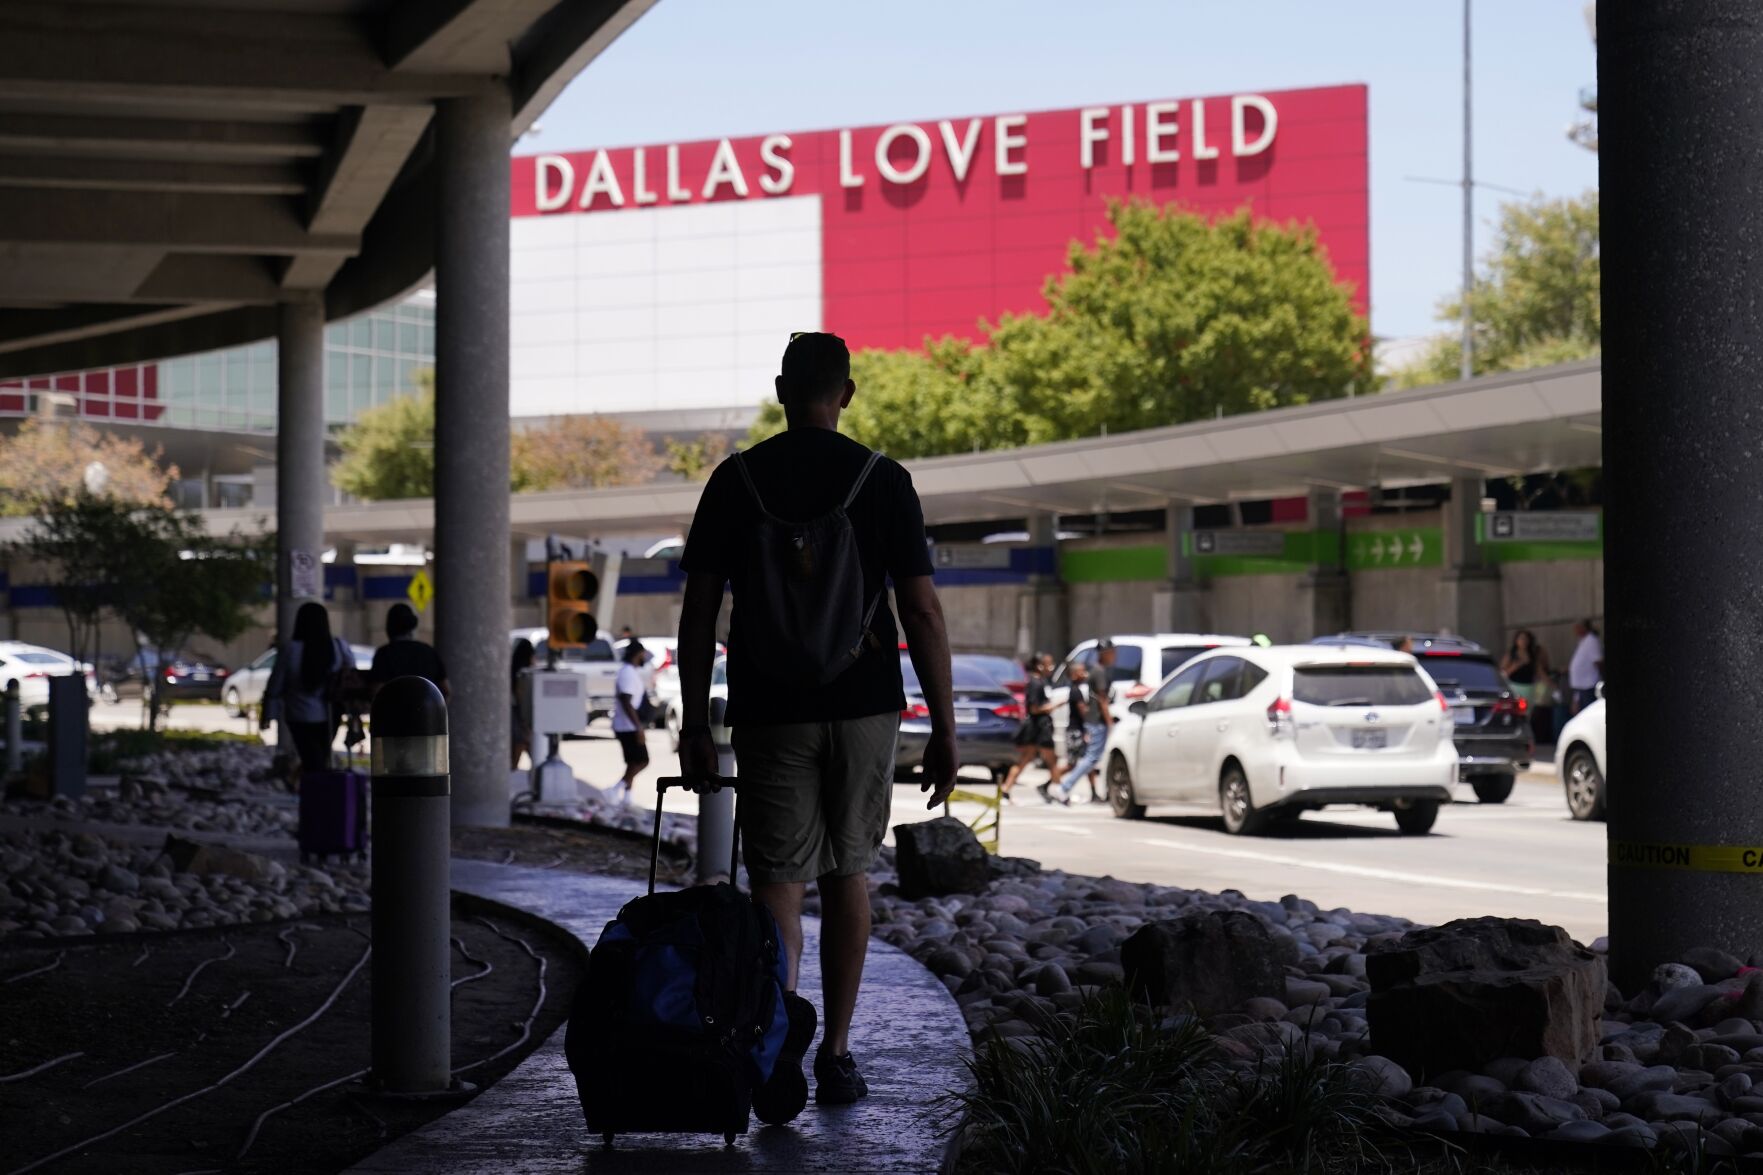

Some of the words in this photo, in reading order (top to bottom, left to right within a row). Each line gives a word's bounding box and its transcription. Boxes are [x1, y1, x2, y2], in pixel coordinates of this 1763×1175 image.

[535, 134, 795, 211] DALLAS
[839, 114, 1028, 188] LOVE
[1080, 94, 1278, 168] FIELD
[1617, 843, 1690, 866] CAUTION
